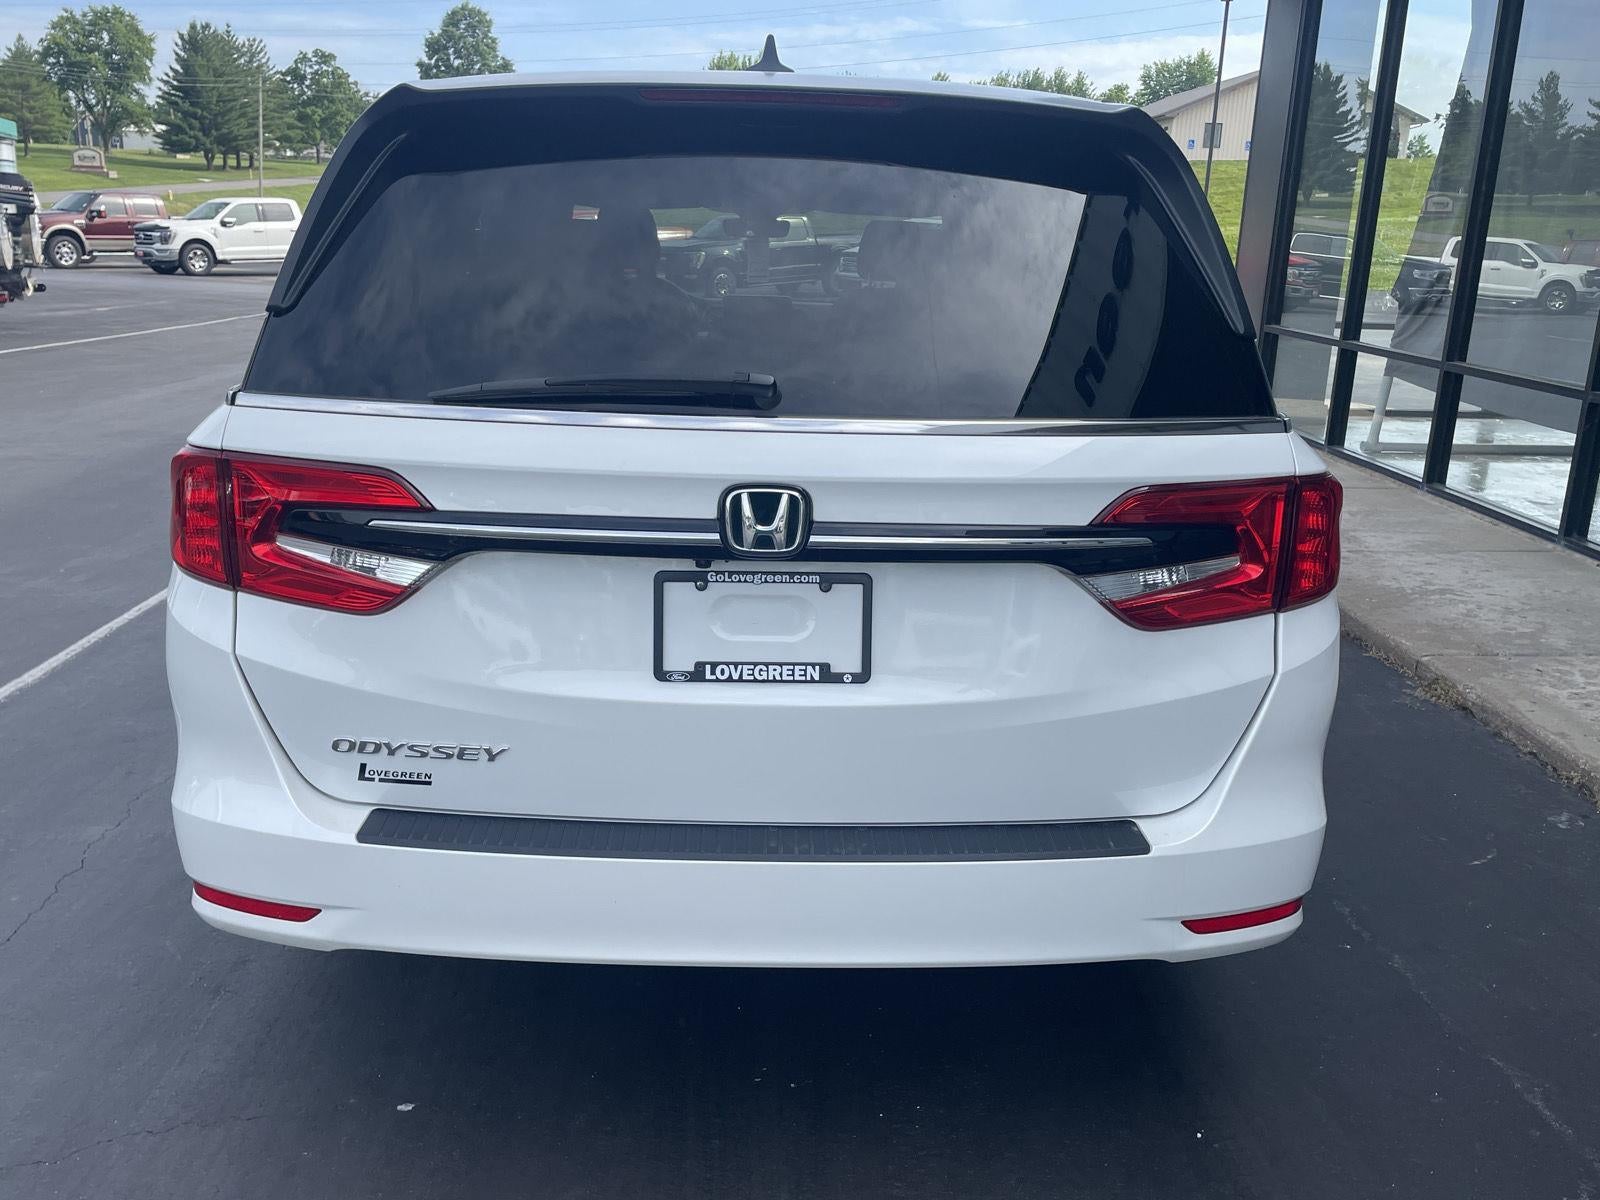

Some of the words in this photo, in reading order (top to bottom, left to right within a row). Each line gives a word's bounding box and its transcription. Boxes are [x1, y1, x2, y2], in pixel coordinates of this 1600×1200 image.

[707, 572, 820, 585] GoLovegreen.com
[705, 664, 820, 682] LOVEGREEN
[331, 738, 509, 762] ODYSSEY
[358, 763, 432, 782] LOVEGREEN
